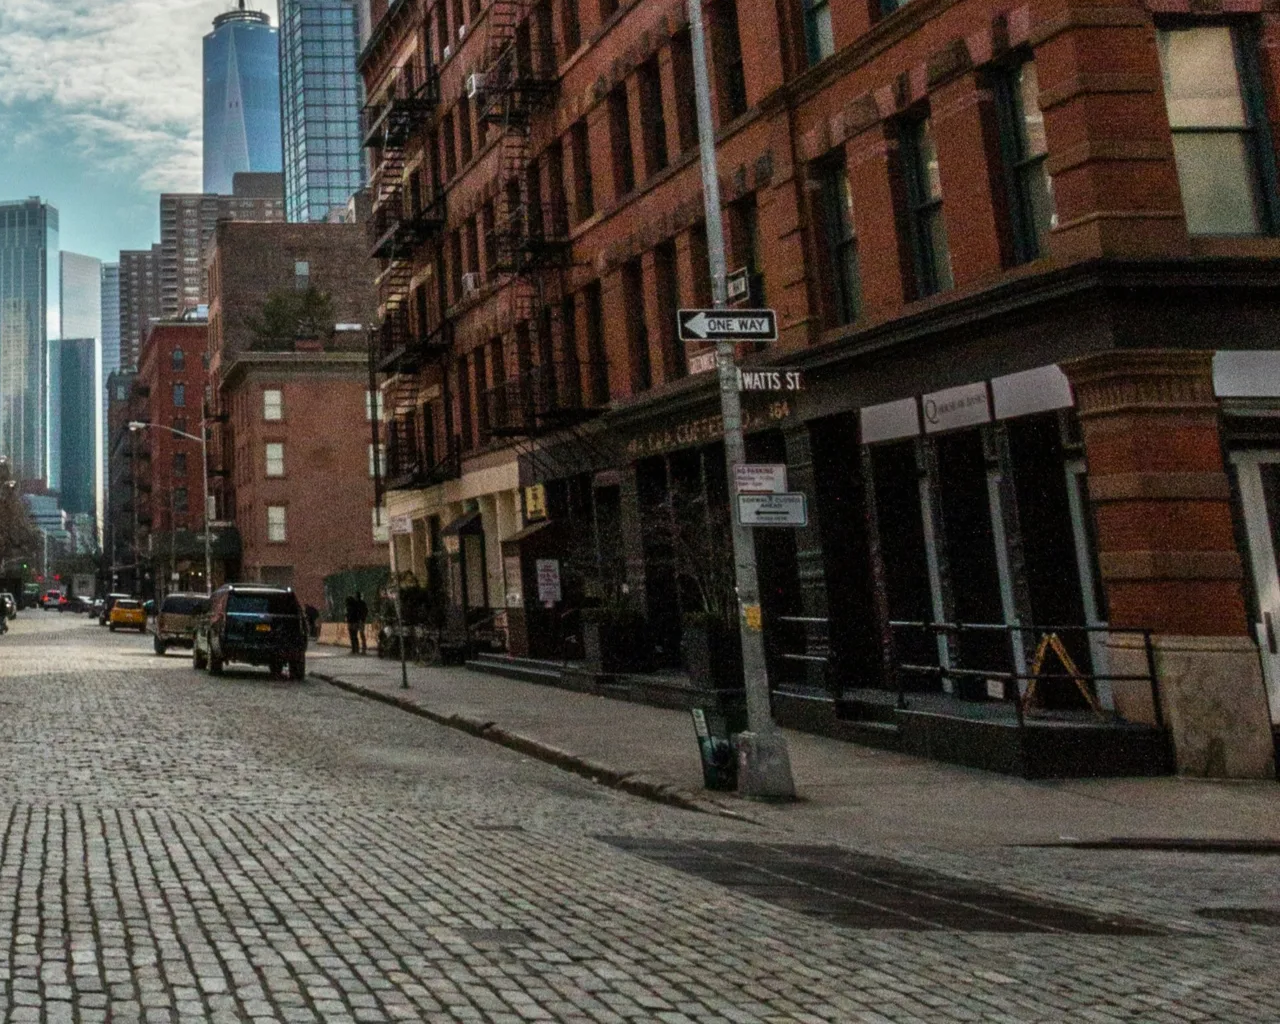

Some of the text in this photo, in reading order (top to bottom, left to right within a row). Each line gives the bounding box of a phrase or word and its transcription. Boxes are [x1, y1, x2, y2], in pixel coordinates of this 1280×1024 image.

[707, 319, 765, 331] ONE WAY
[742, 372, 801, 390] WATTS ST
